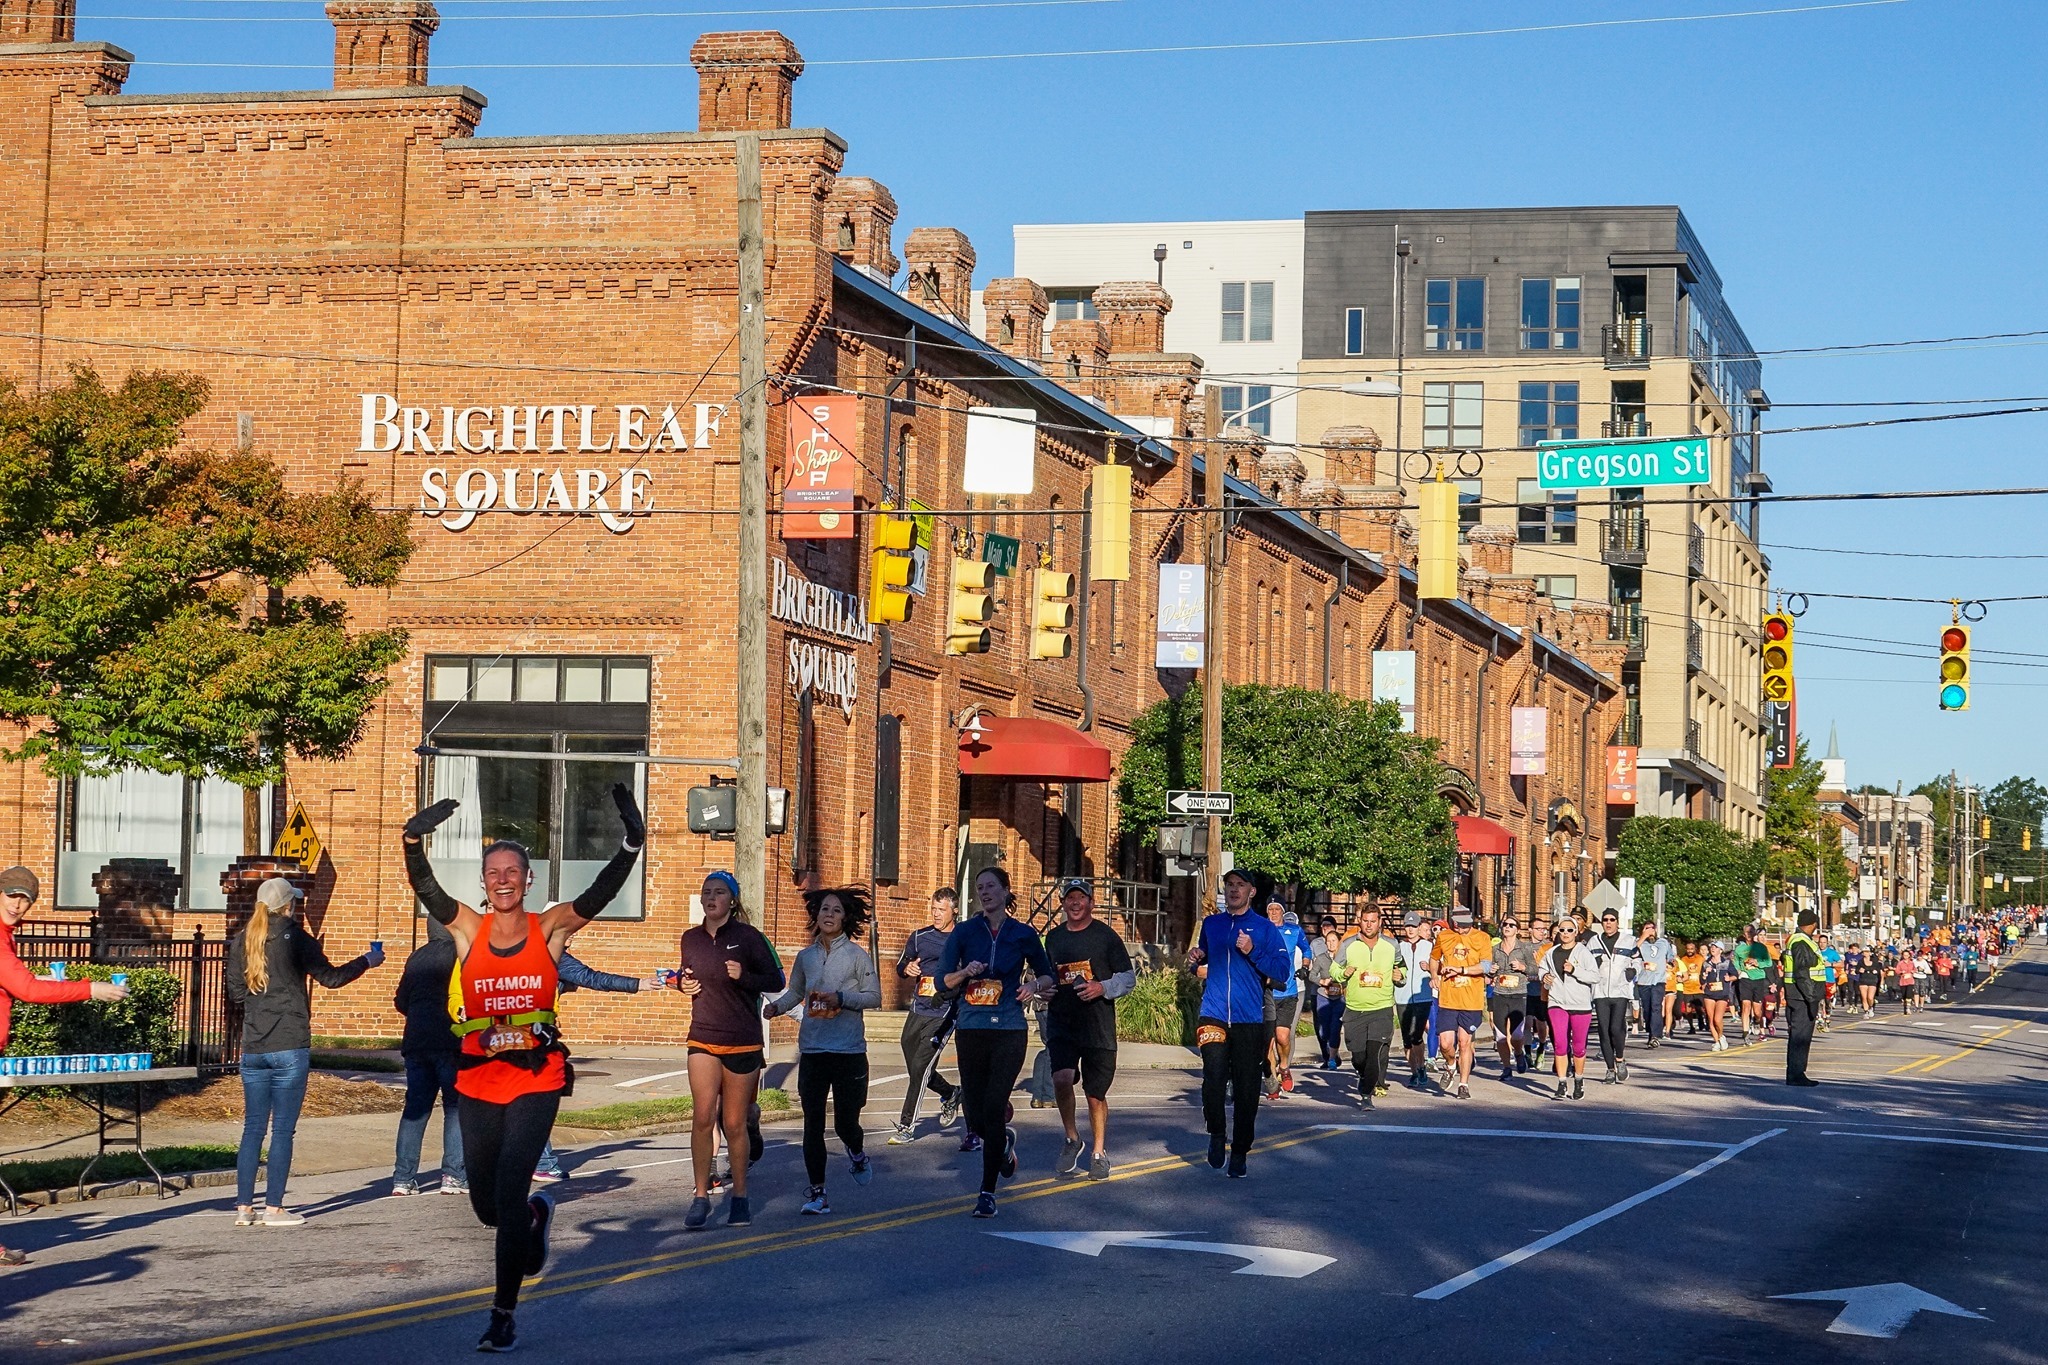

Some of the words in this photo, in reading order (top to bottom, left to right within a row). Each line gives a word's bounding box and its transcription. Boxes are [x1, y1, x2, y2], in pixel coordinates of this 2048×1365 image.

[355, 393, 727, 454] BRIGHTLEAF
[795, 439, 843, 486] Shop
[1541, 450, 1659, 486] Gregson
[1673, 444, 1706, 476] St
[420, 467, 655, 533] SQUARE
[986, 540, 1003, 568] Main
[1004, 545, 1015, 570] St
[788, 637, 859, 719] SQUARE
[1187, 798, 1205, 808] ONE
[1208, 799, 1227, 808] WAY
[474, 975, 542, 993] FIT4MOM
[484, 995, 534, 1012] FIERCE
[490, 1032, 525, 1047] 4132
